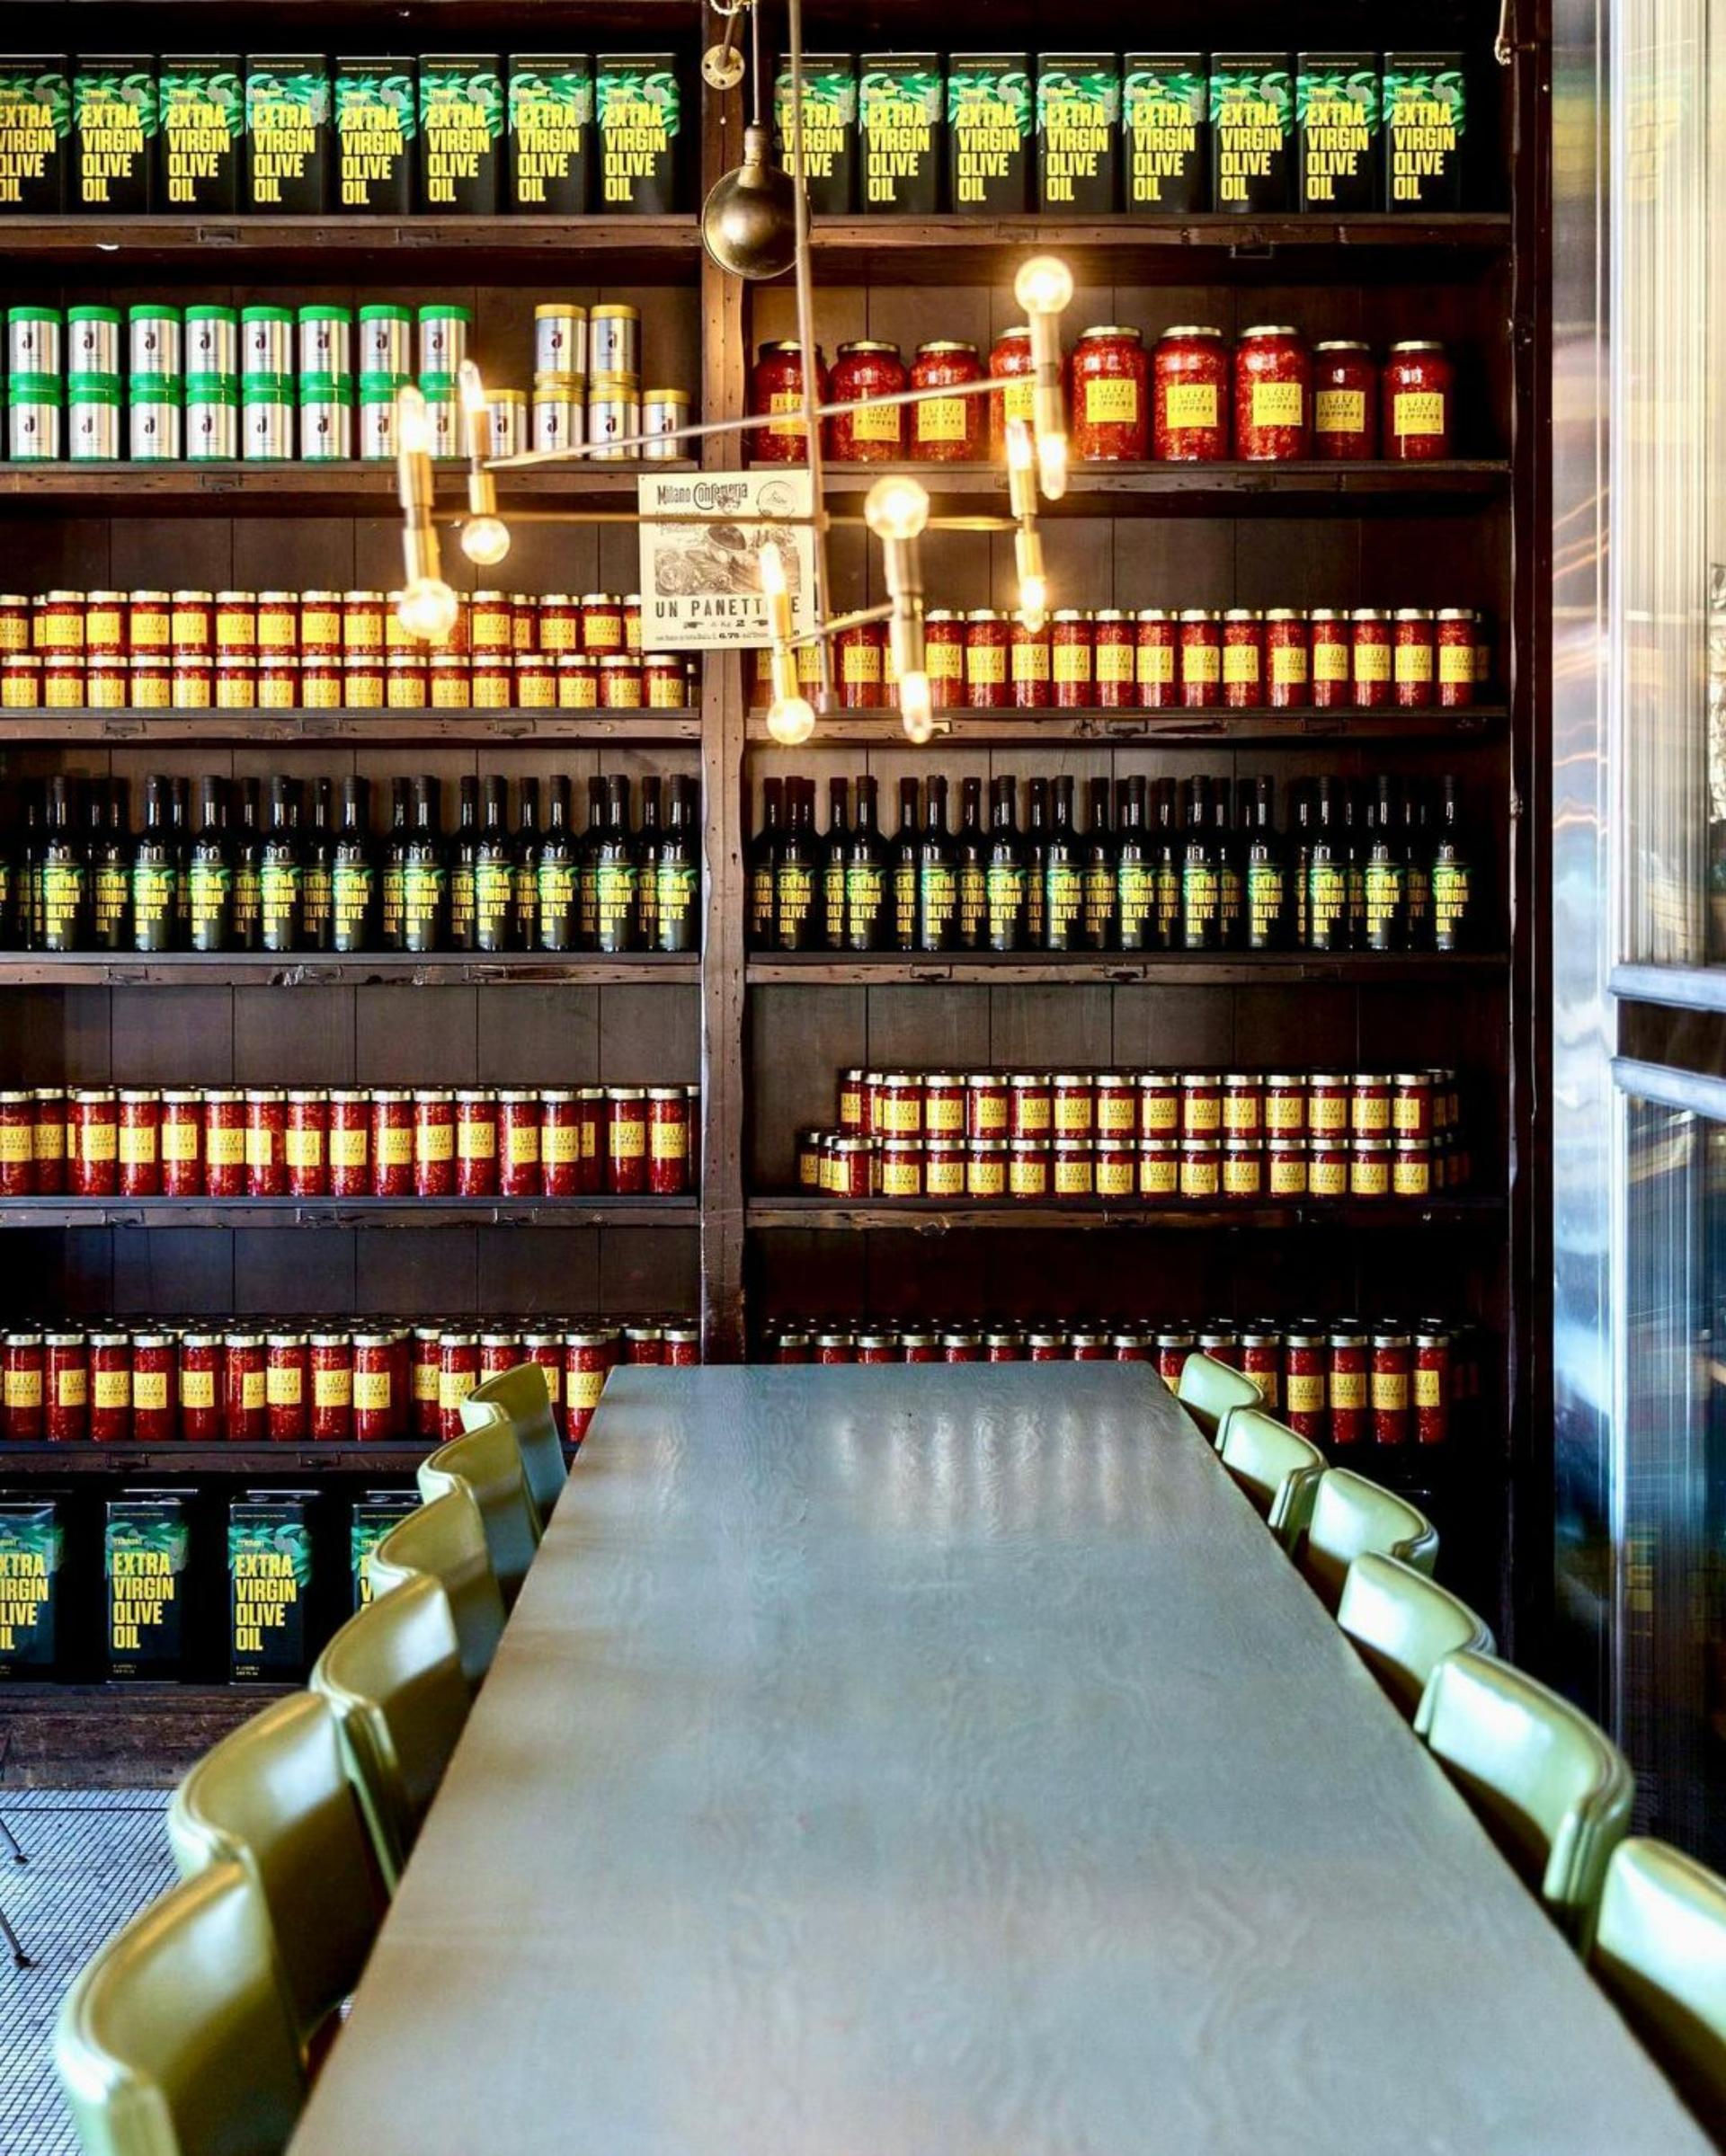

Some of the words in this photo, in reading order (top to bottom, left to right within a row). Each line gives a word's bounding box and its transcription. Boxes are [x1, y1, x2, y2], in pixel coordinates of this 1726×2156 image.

[82, 104, 140, 128] EXTRA
[168, 104, 227, 128] EXTRA
[254, 104, 312, 128] EXTRA
[342, 107, 400, 130] EXTRA
[428, 104, 486, 128] EXTRA
[518, 104, 576, 128] EXTRA
[604, 103, 663, 127] EXTRA
[782, 104, 841, 128] ETRA
[867, 104, 926, 128] EXTRA
[957, 104, 1016, 128] EXTRA
[1046, 103, 1105, 127] EXTRA
[1133, 103, 1191, 127] EXTRA
[1220, 102, 1278, 126] EXTRA
[1307, 102, 1366, 125] EXTRA
[1393, 102, 1452, 125] EXTRA
[82, 129, 144, 152] VIRGIN
[168, 129, 230, 152] VIRGIN
[254, 129, 316, 152] VIRGIN
[342, 131, 404, 155] VIRGIN
[428, 129, 490, 152] VIRGIN
[518, 129, 580, 152] VIRGIN
[604, 128, 666, 151] VIRGIN
[782, 129, 844, 152] VRGIN
[867, 129, 930, 152] VIRGIN
[957, 129, 1019, 152] VIRGIN
[1046, 128, 1108, 151] VIRGIN
[1133, 128, 1195, 151] VIRGIN
[1220, 127, 1282, 150] VIRGIN
[1307, 126, 1369, 149] VIRGIN
[1393, 126, 1455, 149] VIRGIN
[82, 153, 132, 176] OLIVE
[168, 153, 218, 176] OLIVE
[254, 153, 304, 176] OLIVE
[342, 155, 392, 179] OLIVE
[428, 153, 478, 176] OLIVE
[518, 153, 568, 176] OLIVE
[604, 152, 654, 175] OLIVE
[782, 153, 832, 176] OIVE
[867, 153, 918, 176] OLIVE
[957, 153, 1008, 176] OLIVE
[1046, 152, 1097, 175] OLIVE
[1133, 152, 1183, 175] OLIVE
[1220, 151, 1270, 174] OLIVE
[1307, 150, 1357, 173] OLIVE
[1393, 150, 1444, 173] OLIVE
[82, 178, 110, 202] OIL
[168, 178, 196, 202] OIL
[254, 178, 281, 202] OIL
[342, 181, 369, 205] OIL
[428, 178, 456, 202] OIL
[518, 178, 546, 202] OIL
[604, 177, 632, 201] OIL
[867, 178, 895, 202] OIL
[957, 178, 985, 202] OIL
[1046, 177, 1074, 201] OIL
[1133, 177, 1161, 201] OIL
[1220, 176, 1248, 200] OIL
[1307, 175, 1335, 200] OIL
[1393, 175, 1421, 200] OIL
[655, 601, 679, 618] UN
[690, 596, 800, 617] PANETTE
[779, 875, 810, 889] EXTRA
[850, 875, 880, 889] EXTRA
[1367, 874, 1398, 889] EXTRA
[1437, 874, 1467, 889] EXTRA
[779, 890, 811, 903] VIRGIN
[850, 890, 881, 903] VIRGIN
[1367, 889, 1400, 903] VIRGIN
[1437, 889, 1468, 903] VIRGIN
[779, 905, 805, 918] OLIVE
[850, 905, 876, 918] OLIVE
[1367, 904, 1393, 918] OLIVE
[1437, 904, 1464, 918] OLIVE
[0, 1553, 46, 1576] XTRA
[114, 1553, 171, 1575] EXTRA
[236, 1556, 293, 1578] EXTRA
[0, 1578, 49, 1601] IRGIN
[114, 1577, 174, 1601] VIRGIN
[236, 1580, 297, 1603] VIRGIN
[0, 1602, 38, 1626] LIVE
[114, 1601, 163, 1625] OLIVE
[236, 1604, 285, 1628] OLIVE
[0, 1627, 15, 1650] IL
[114, 1626, 141, 1649] OIL
[236, 1628, 263, 1652] OIL
